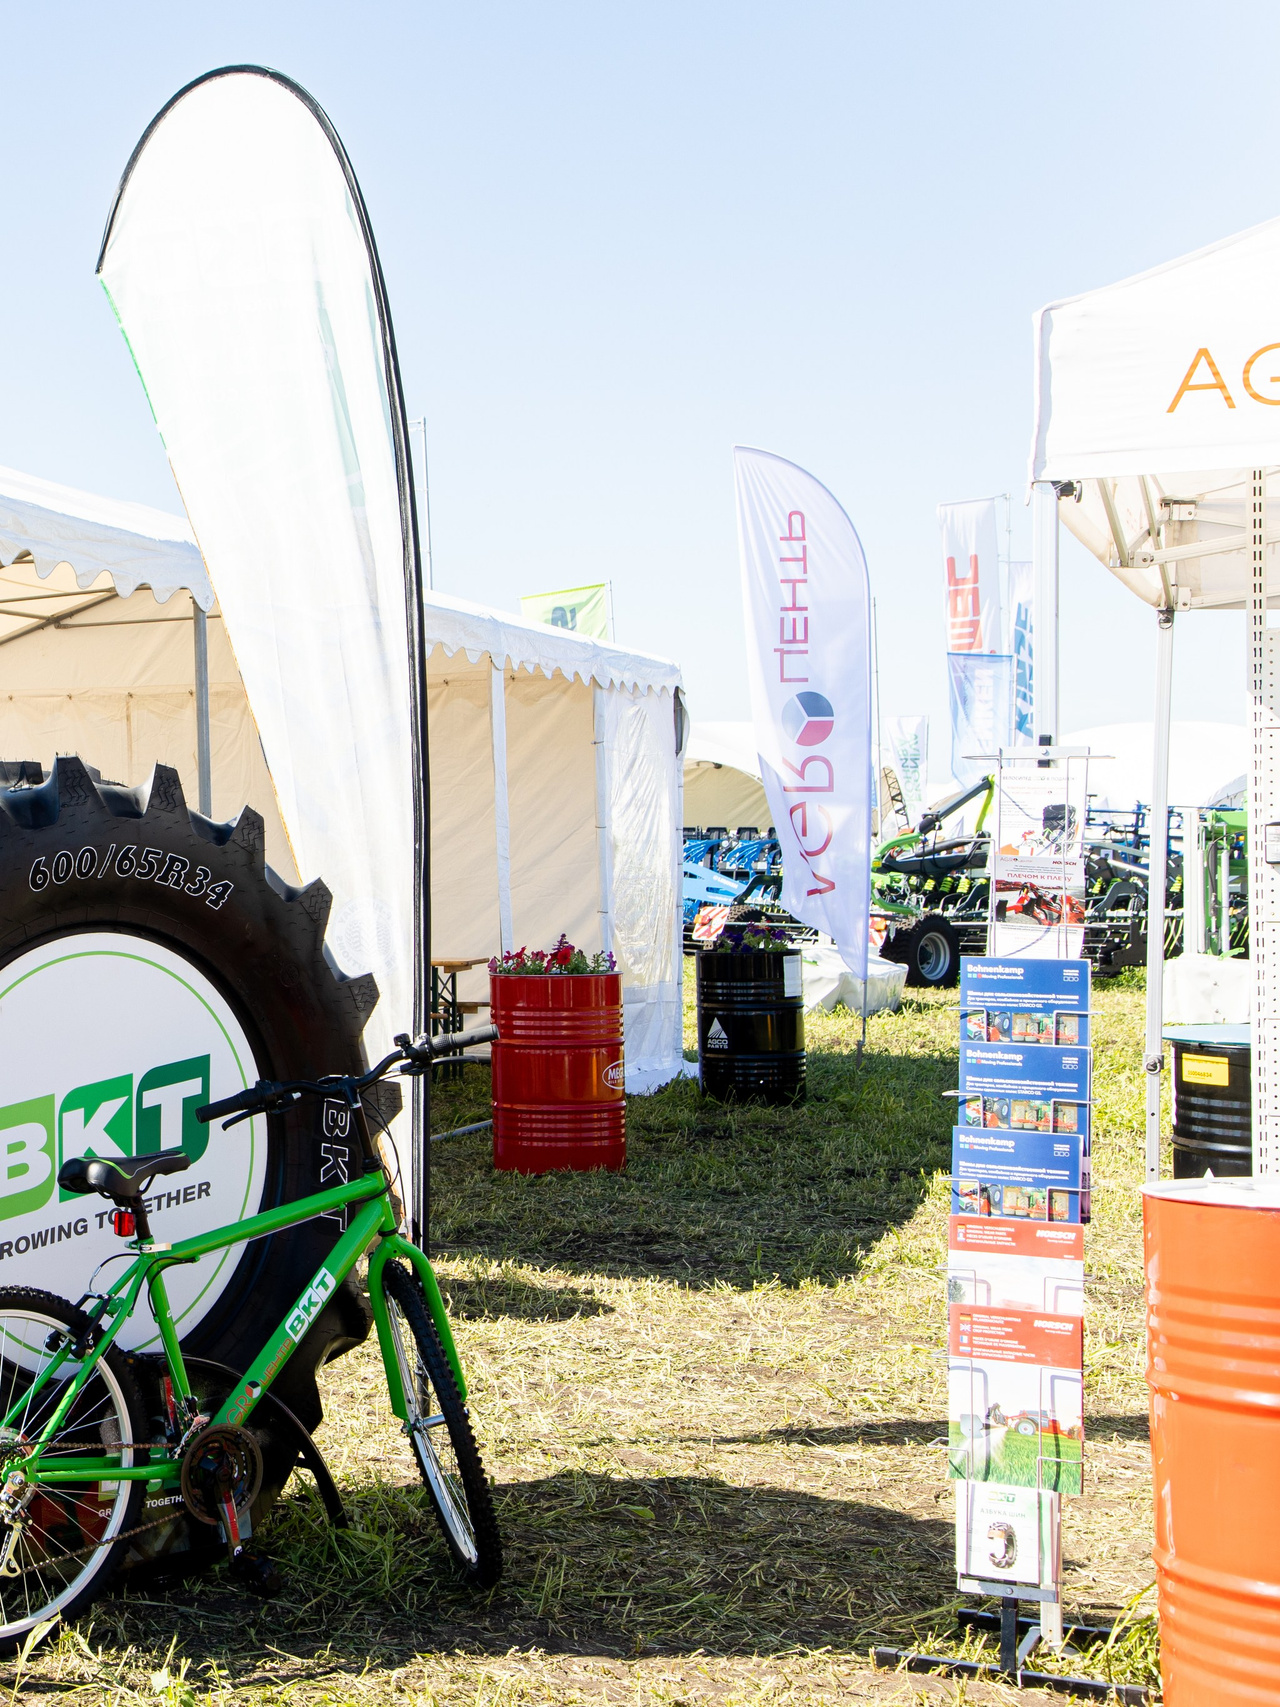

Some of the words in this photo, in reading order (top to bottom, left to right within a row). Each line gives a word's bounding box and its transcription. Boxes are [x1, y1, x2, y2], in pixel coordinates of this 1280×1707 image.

[29, 842, 234, 911] 600/65R34
[967, 964, 1024, 974] Bohnenkamp
[966, 1050, 1023, 1061] Bohnenkamp
[959, 1134, 1015, 1147] Bohnenkamp
[95, 1181, 211, 1230] TOETHER
[1036, 1230, 1076, 1240] HORSCH
[286, 1269, 334, 1341] BKT
[1034, 1320, 1074, 1331] HORSCH
[980, 1507, 1007, 1517] АЗБУКА
[1008, 1511, 1026, 1519] ШИН
